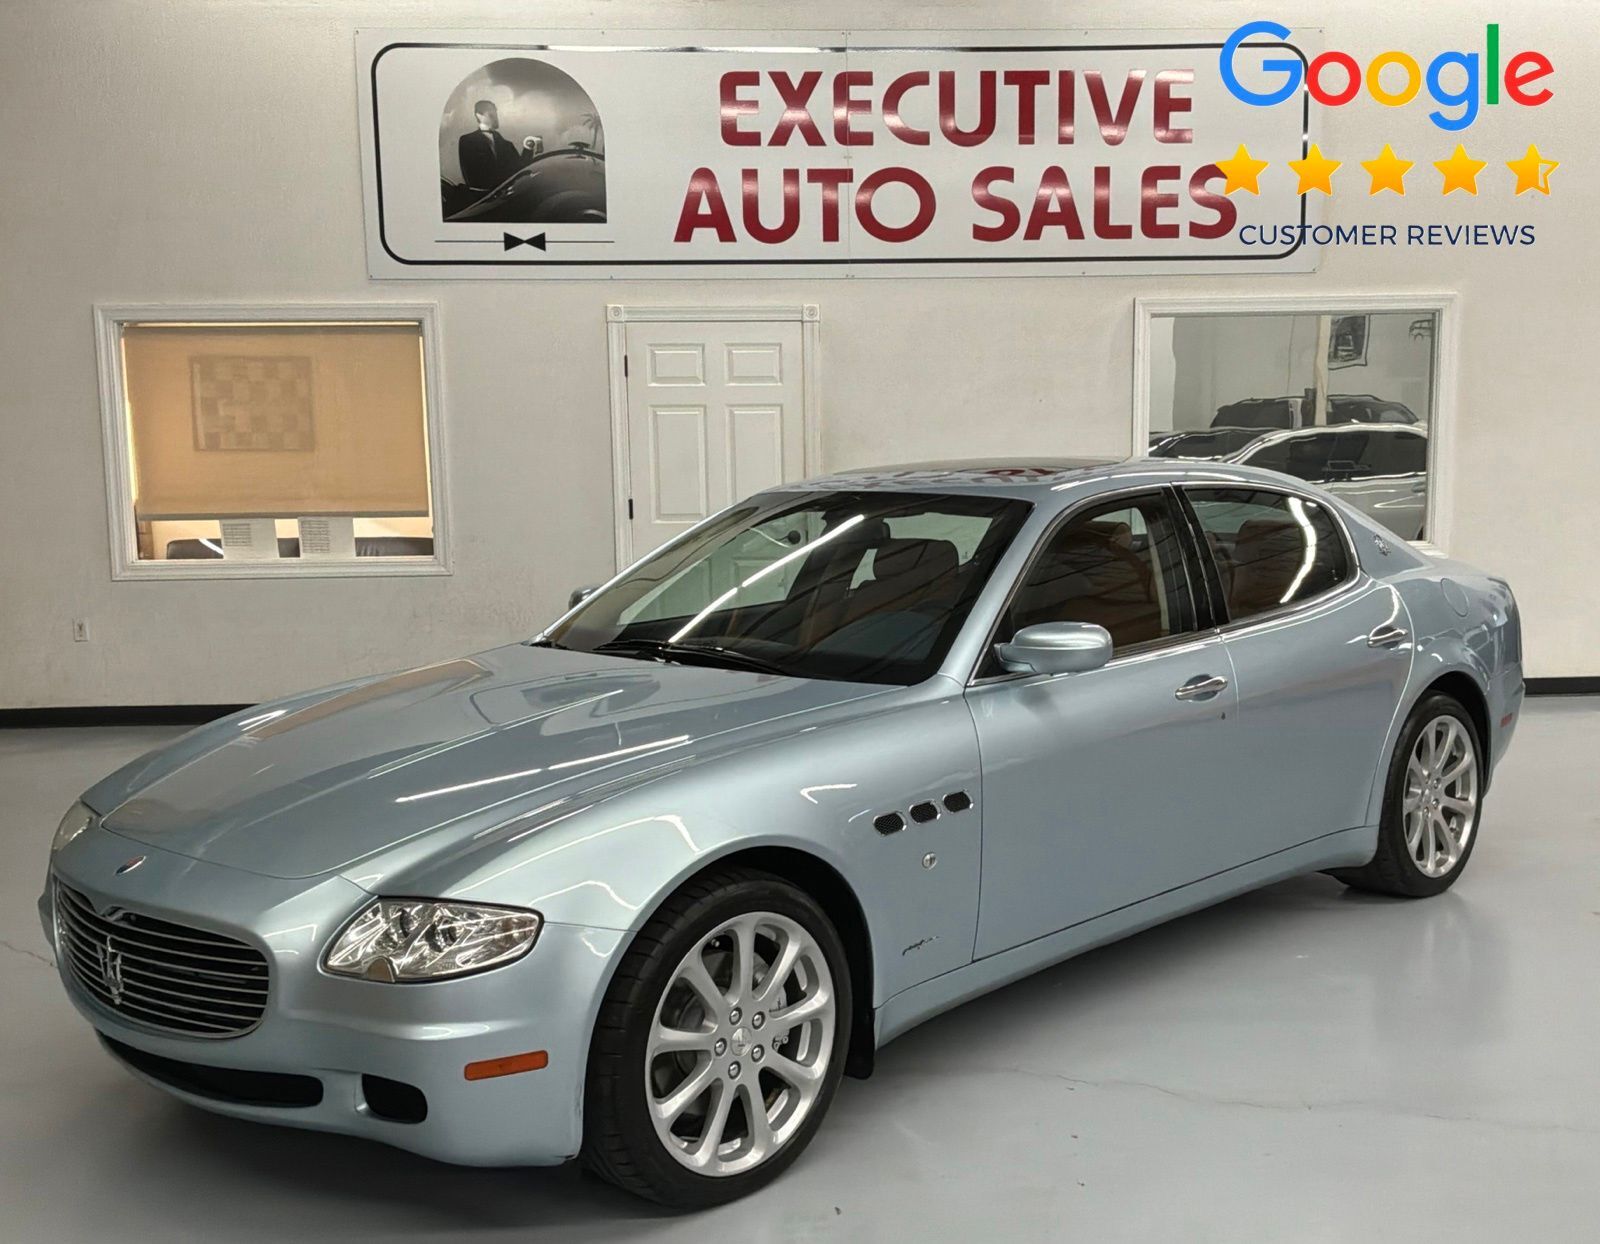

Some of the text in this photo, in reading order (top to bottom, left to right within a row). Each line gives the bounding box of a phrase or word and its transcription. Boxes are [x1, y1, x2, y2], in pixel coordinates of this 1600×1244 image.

[719, 69, 1194, 148] EXECUTIVE
[674, 163, 1237, 244] AUTO SALES
